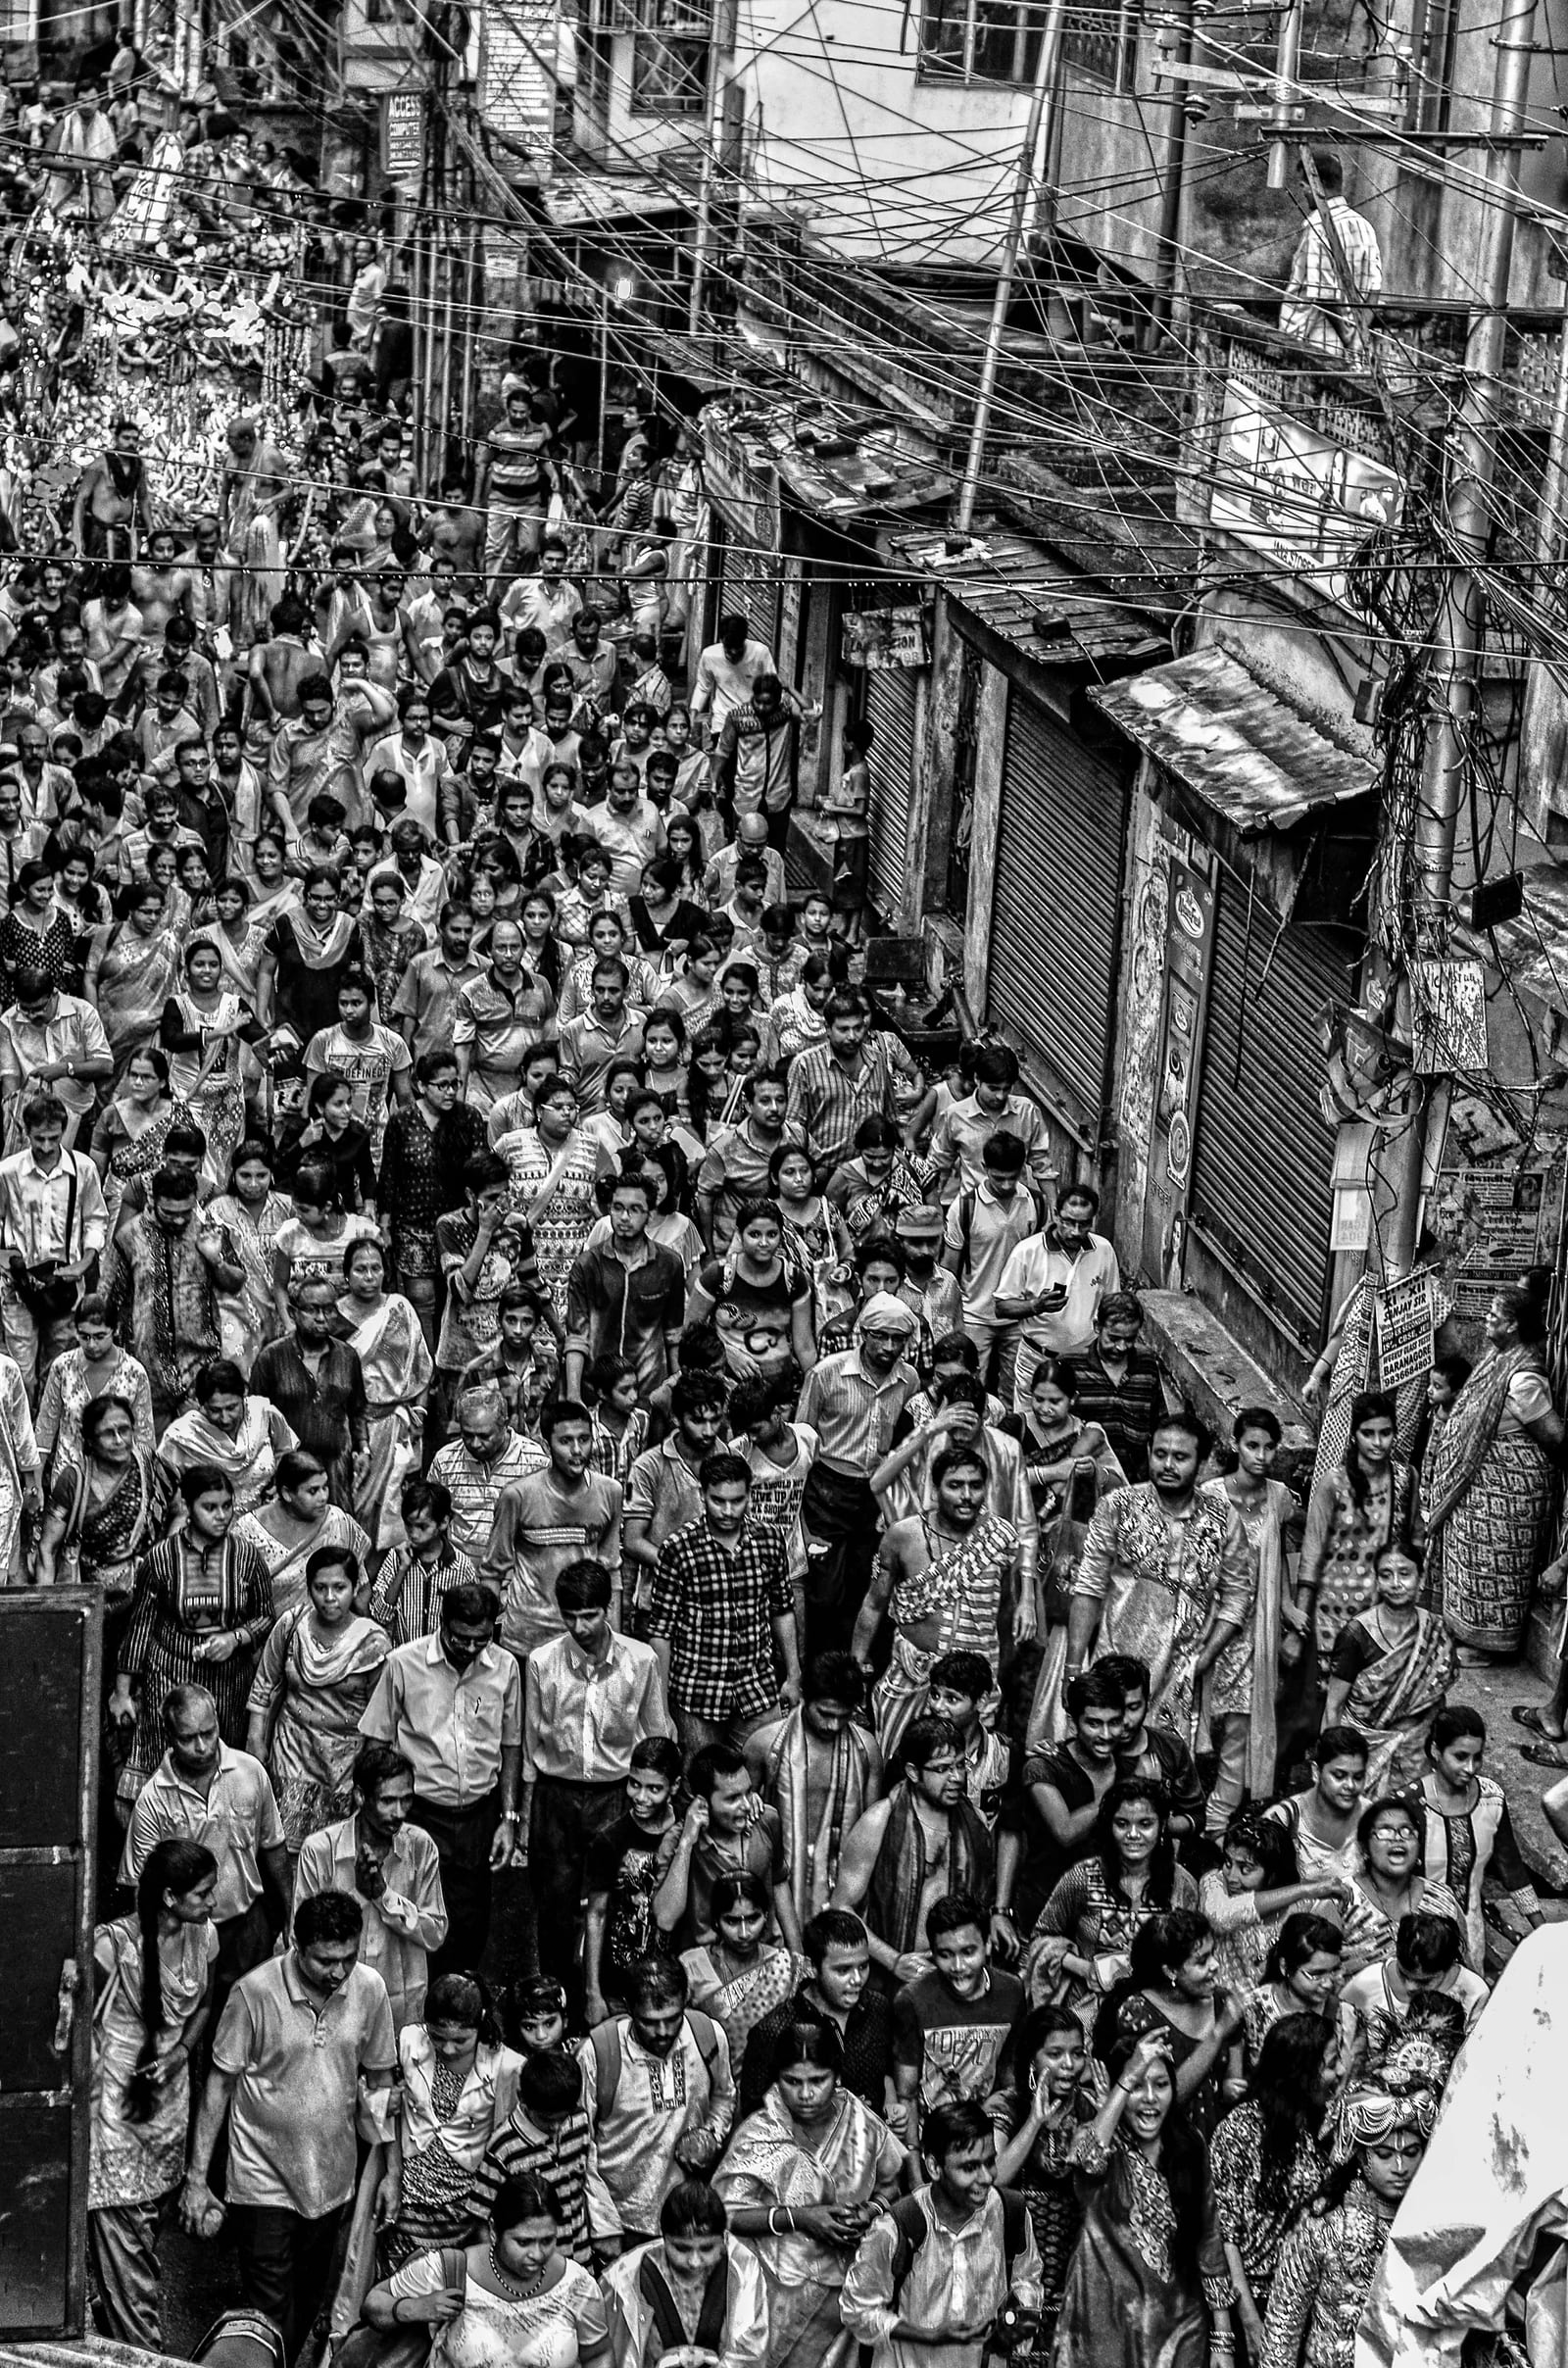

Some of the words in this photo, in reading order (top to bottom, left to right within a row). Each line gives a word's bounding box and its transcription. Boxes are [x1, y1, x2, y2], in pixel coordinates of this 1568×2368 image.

[389, 95, 420, 117] ACCESS
[1408, 1280, 1425, 1297] XII
[1414, 1293, 1427, 1307] SIR
[1384, 1344, 1431, 1376] BARANAGORE
[751, 1491, 772, 1503] GIVE
[774, 1491, 787, 1504] UP
